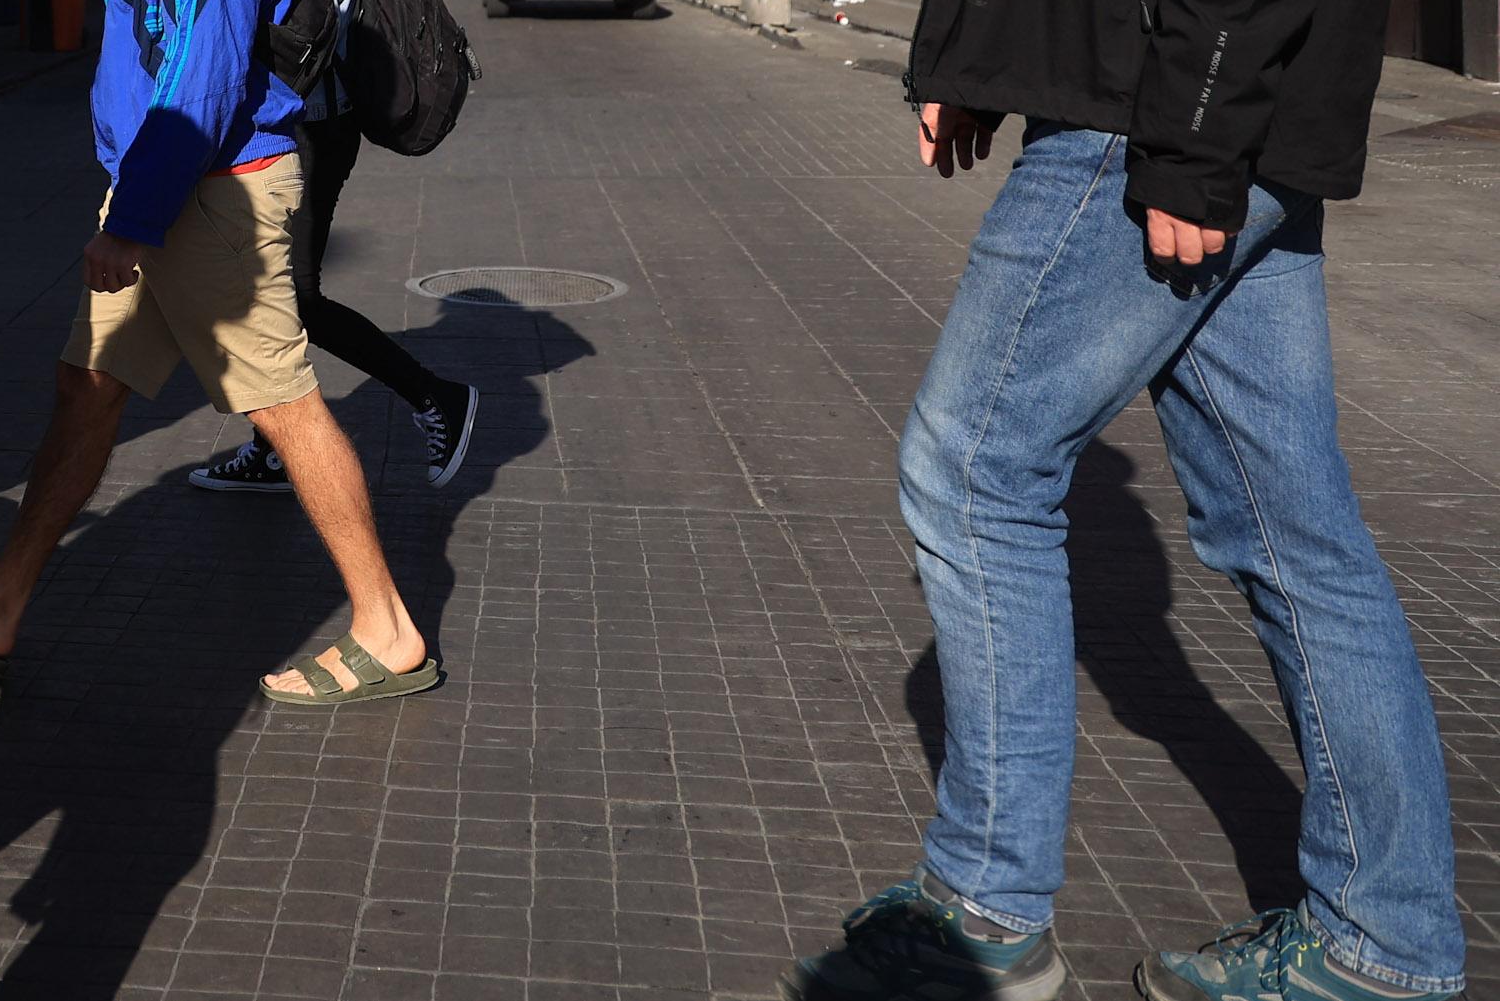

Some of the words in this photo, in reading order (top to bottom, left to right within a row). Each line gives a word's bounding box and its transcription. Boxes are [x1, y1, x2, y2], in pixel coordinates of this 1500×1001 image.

[1217, 31, 1228, 48] FAT
[1209, 50, 1222, 76] MOOSE
[1199, 87, 1212, 104] FAT
[1191, 107, 1205, 132] MOOSE
